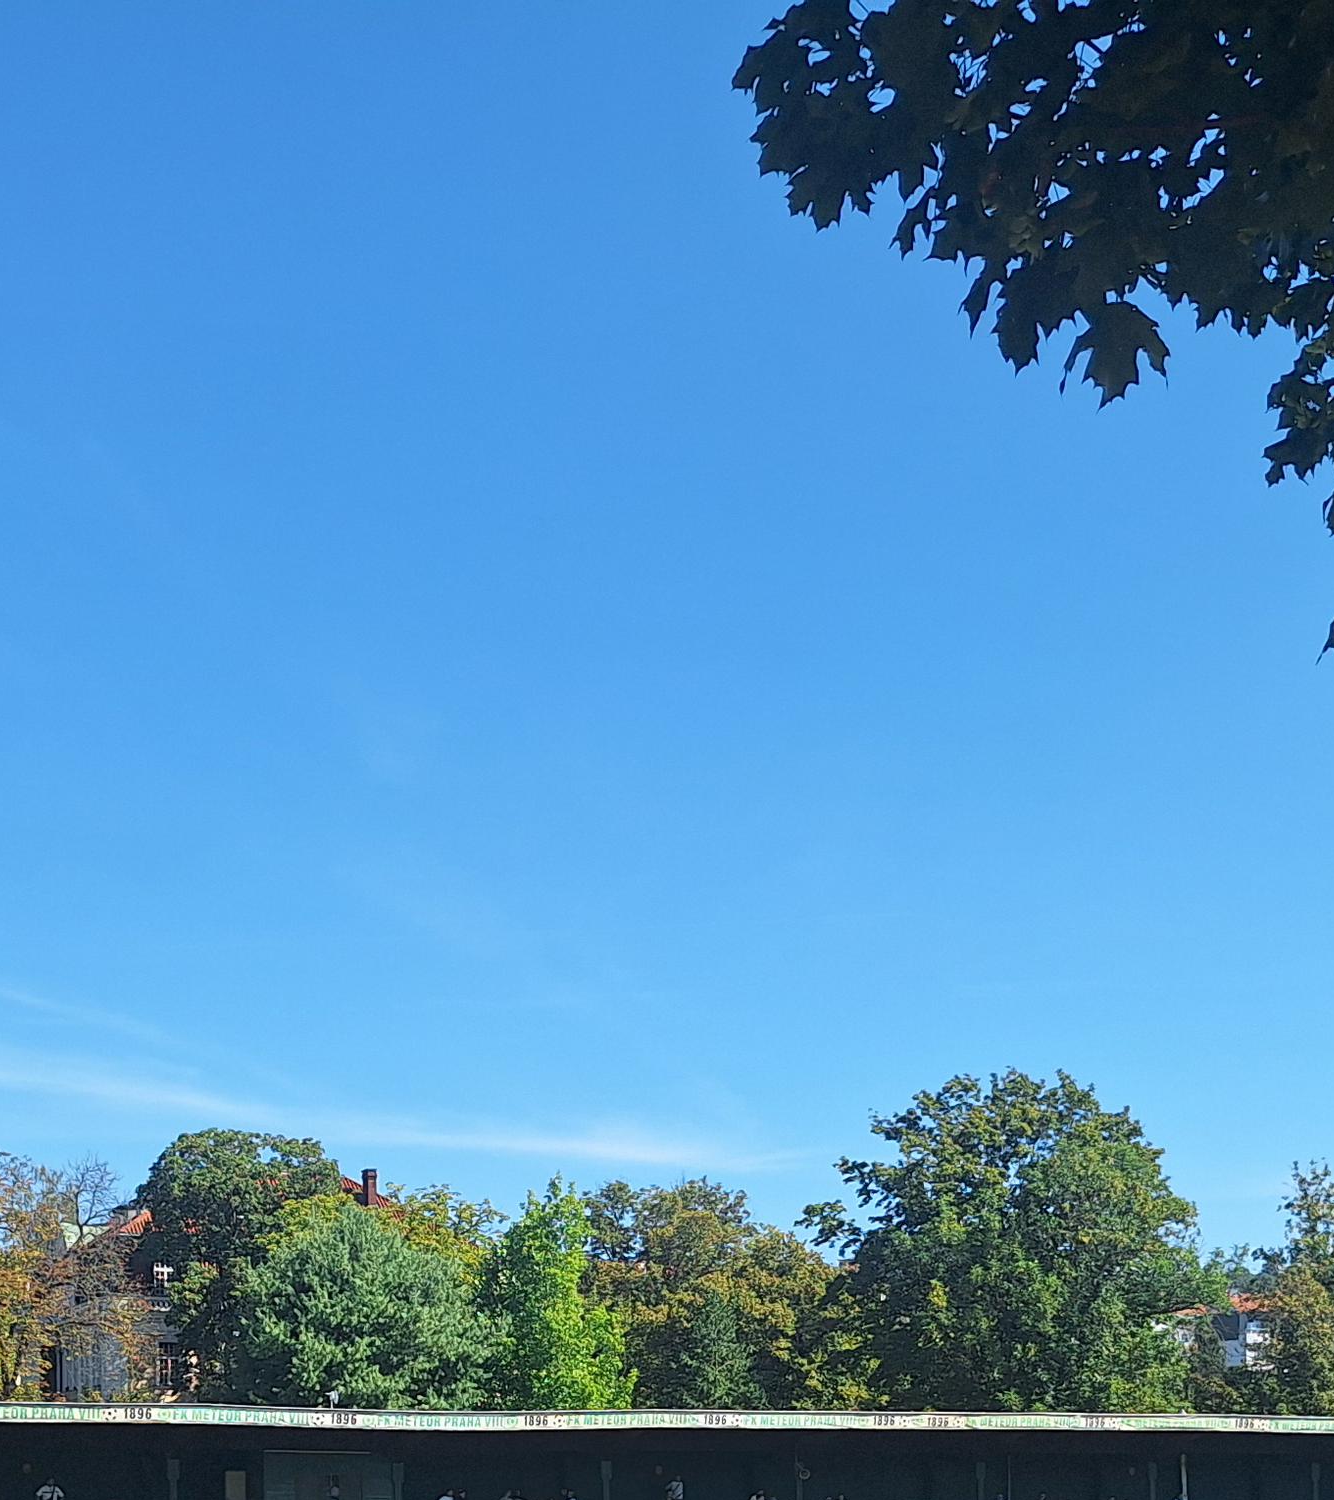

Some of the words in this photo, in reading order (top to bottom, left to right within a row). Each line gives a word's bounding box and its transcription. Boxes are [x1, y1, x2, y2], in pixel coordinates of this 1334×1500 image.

[32, 1408, 75, 1420] PRAHA
[124, 1408, 152, 1419] 1896
[172, 1410, 187, 1420] FK
[192, 1410, 241, 1422] METEOR
[245, 1411, 284, 1423] PRAHA
[330, 1413, 357, 1425] 1896
[377, 1415, 390, 1425] FK
[394, 1414, 440, 1426] METEOR
[444, 1415, 481, 1427] PRAHA
[524, 1415, 548, 1426] 1896
[566, 1415, 580, 1425] FK
[583, 1414, 627, 1426] METEOR
[703, 1414, 727, 1425] 1896
[760, 1415, 800, 1427] METEOR
[804, 1416, 836, 1427] PRAHA
[873, 1415, 895, 1426] 1896
[927, 1416, 949, 1427] 1896
[1086, 1417, 1105, 1427] 1896
[1235, 1418, 1254, 1428] 1896
